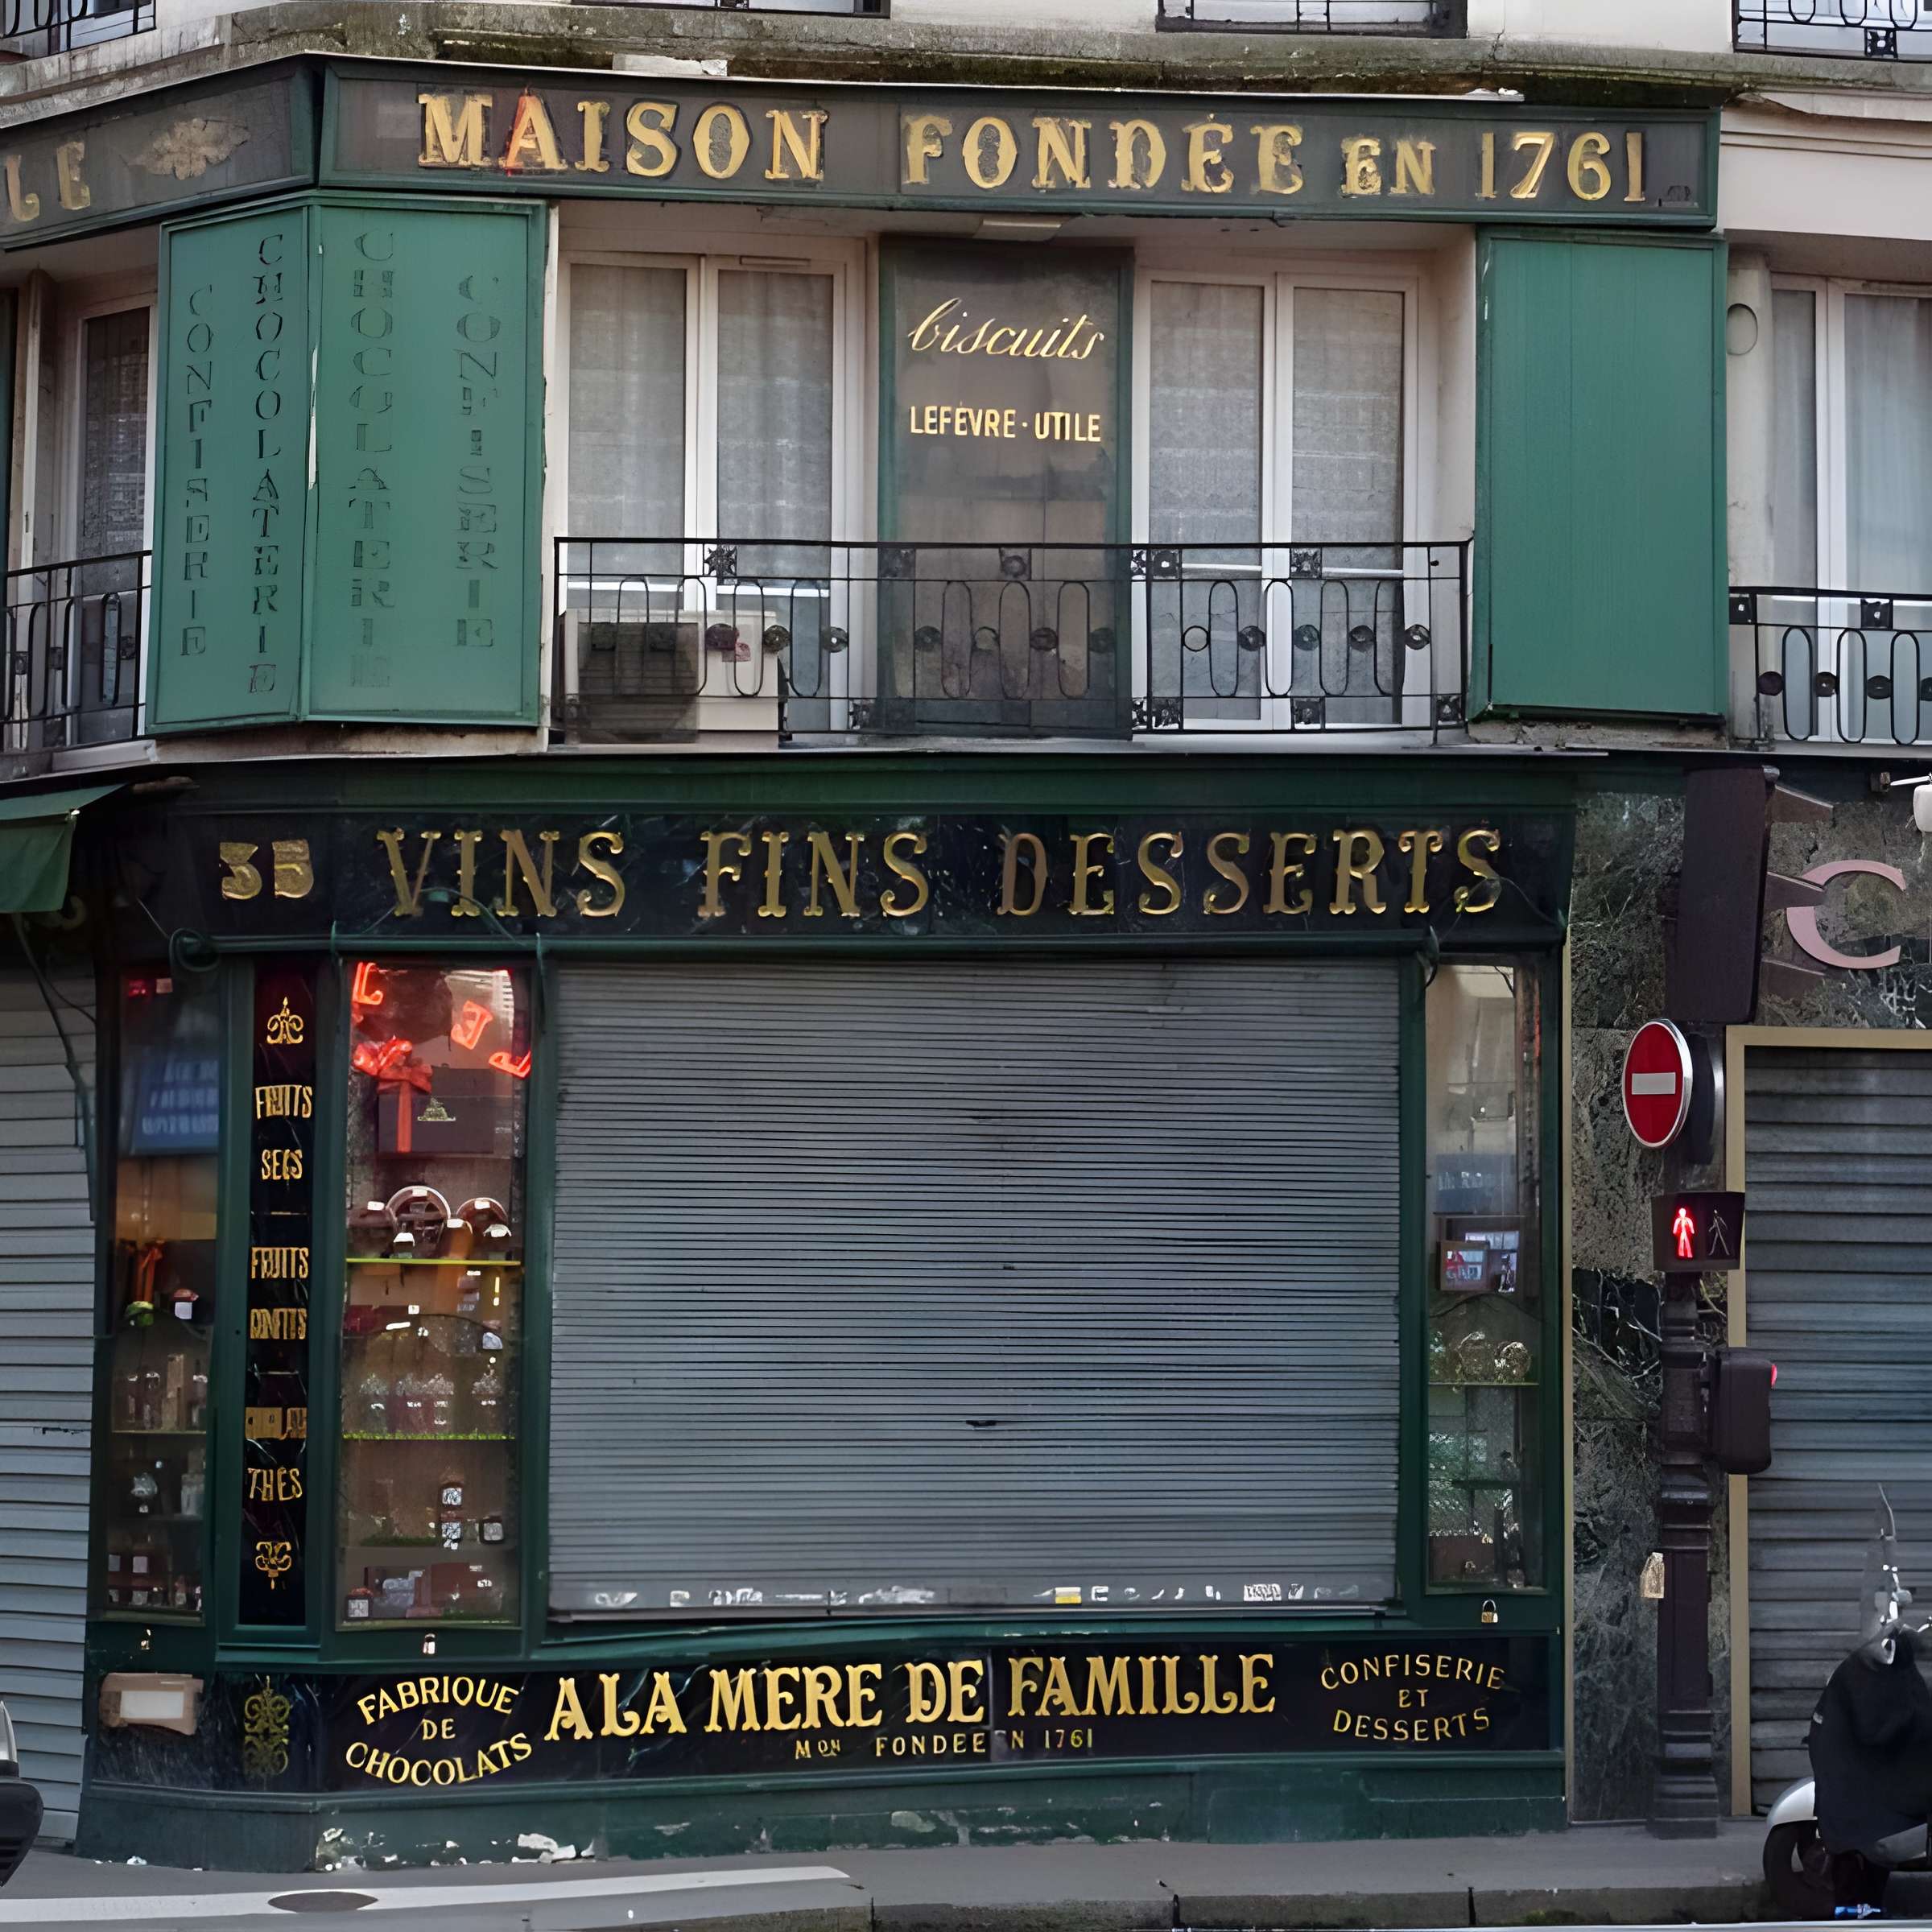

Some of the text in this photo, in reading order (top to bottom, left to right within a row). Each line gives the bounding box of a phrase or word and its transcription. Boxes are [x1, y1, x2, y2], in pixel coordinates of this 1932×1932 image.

[419, 93, 828, 179] MAISON
[1340, 138, 1437, 196] EN
[1478, 130, 1647, 201] 1761
[908, 296, 1104, 359] biscuits
[1034, 411, 1101, 442] UTILE
[376, 828, 1502, 918] VINS FINS DESSERTS
[251, 1247, 309, 1279] FRUITS
[1321, 1654, 1505, 1690] CONFISERIE
[357, 1676, 519, 1725] FABRIQUE
[704, 1663, 883, 1732] MERE
[903, 1659, 985, 1724] DE
[1008, 1653, 1277, 1717] FAMILLE
[1399, 1689, 1429, 1708] ET
[422, 1719, 456, 1740] DE
[1333, 1707, 1489, 1741] DESSERTS
[346, 1732, 532, 1786] CHOCOLATS
[876, 1732, 986, 1757] FONDEE
[1045, 1728, 1093, 1748] 1761
